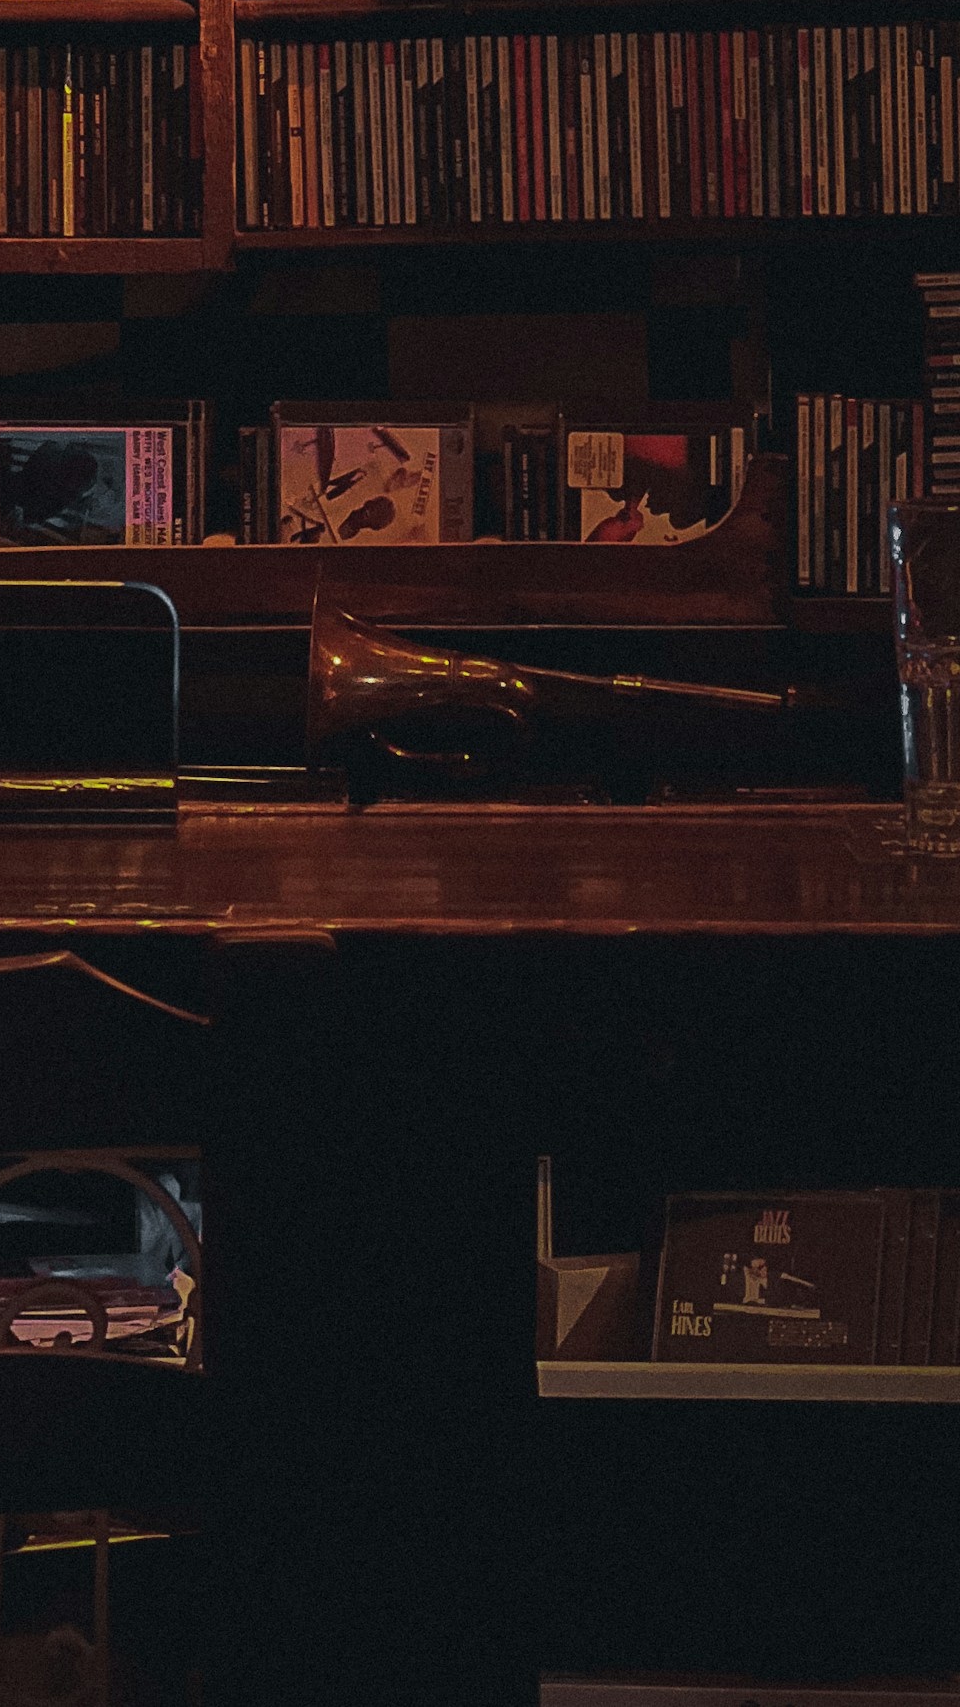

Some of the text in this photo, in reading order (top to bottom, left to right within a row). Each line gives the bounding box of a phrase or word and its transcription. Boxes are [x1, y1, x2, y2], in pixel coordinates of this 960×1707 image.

[157, 431, 167, 456] West
[157, 458, 167, 489] Coast
[157, 492, 167, 525] Blues!
[671, 1315, 713, 1337] HINES
